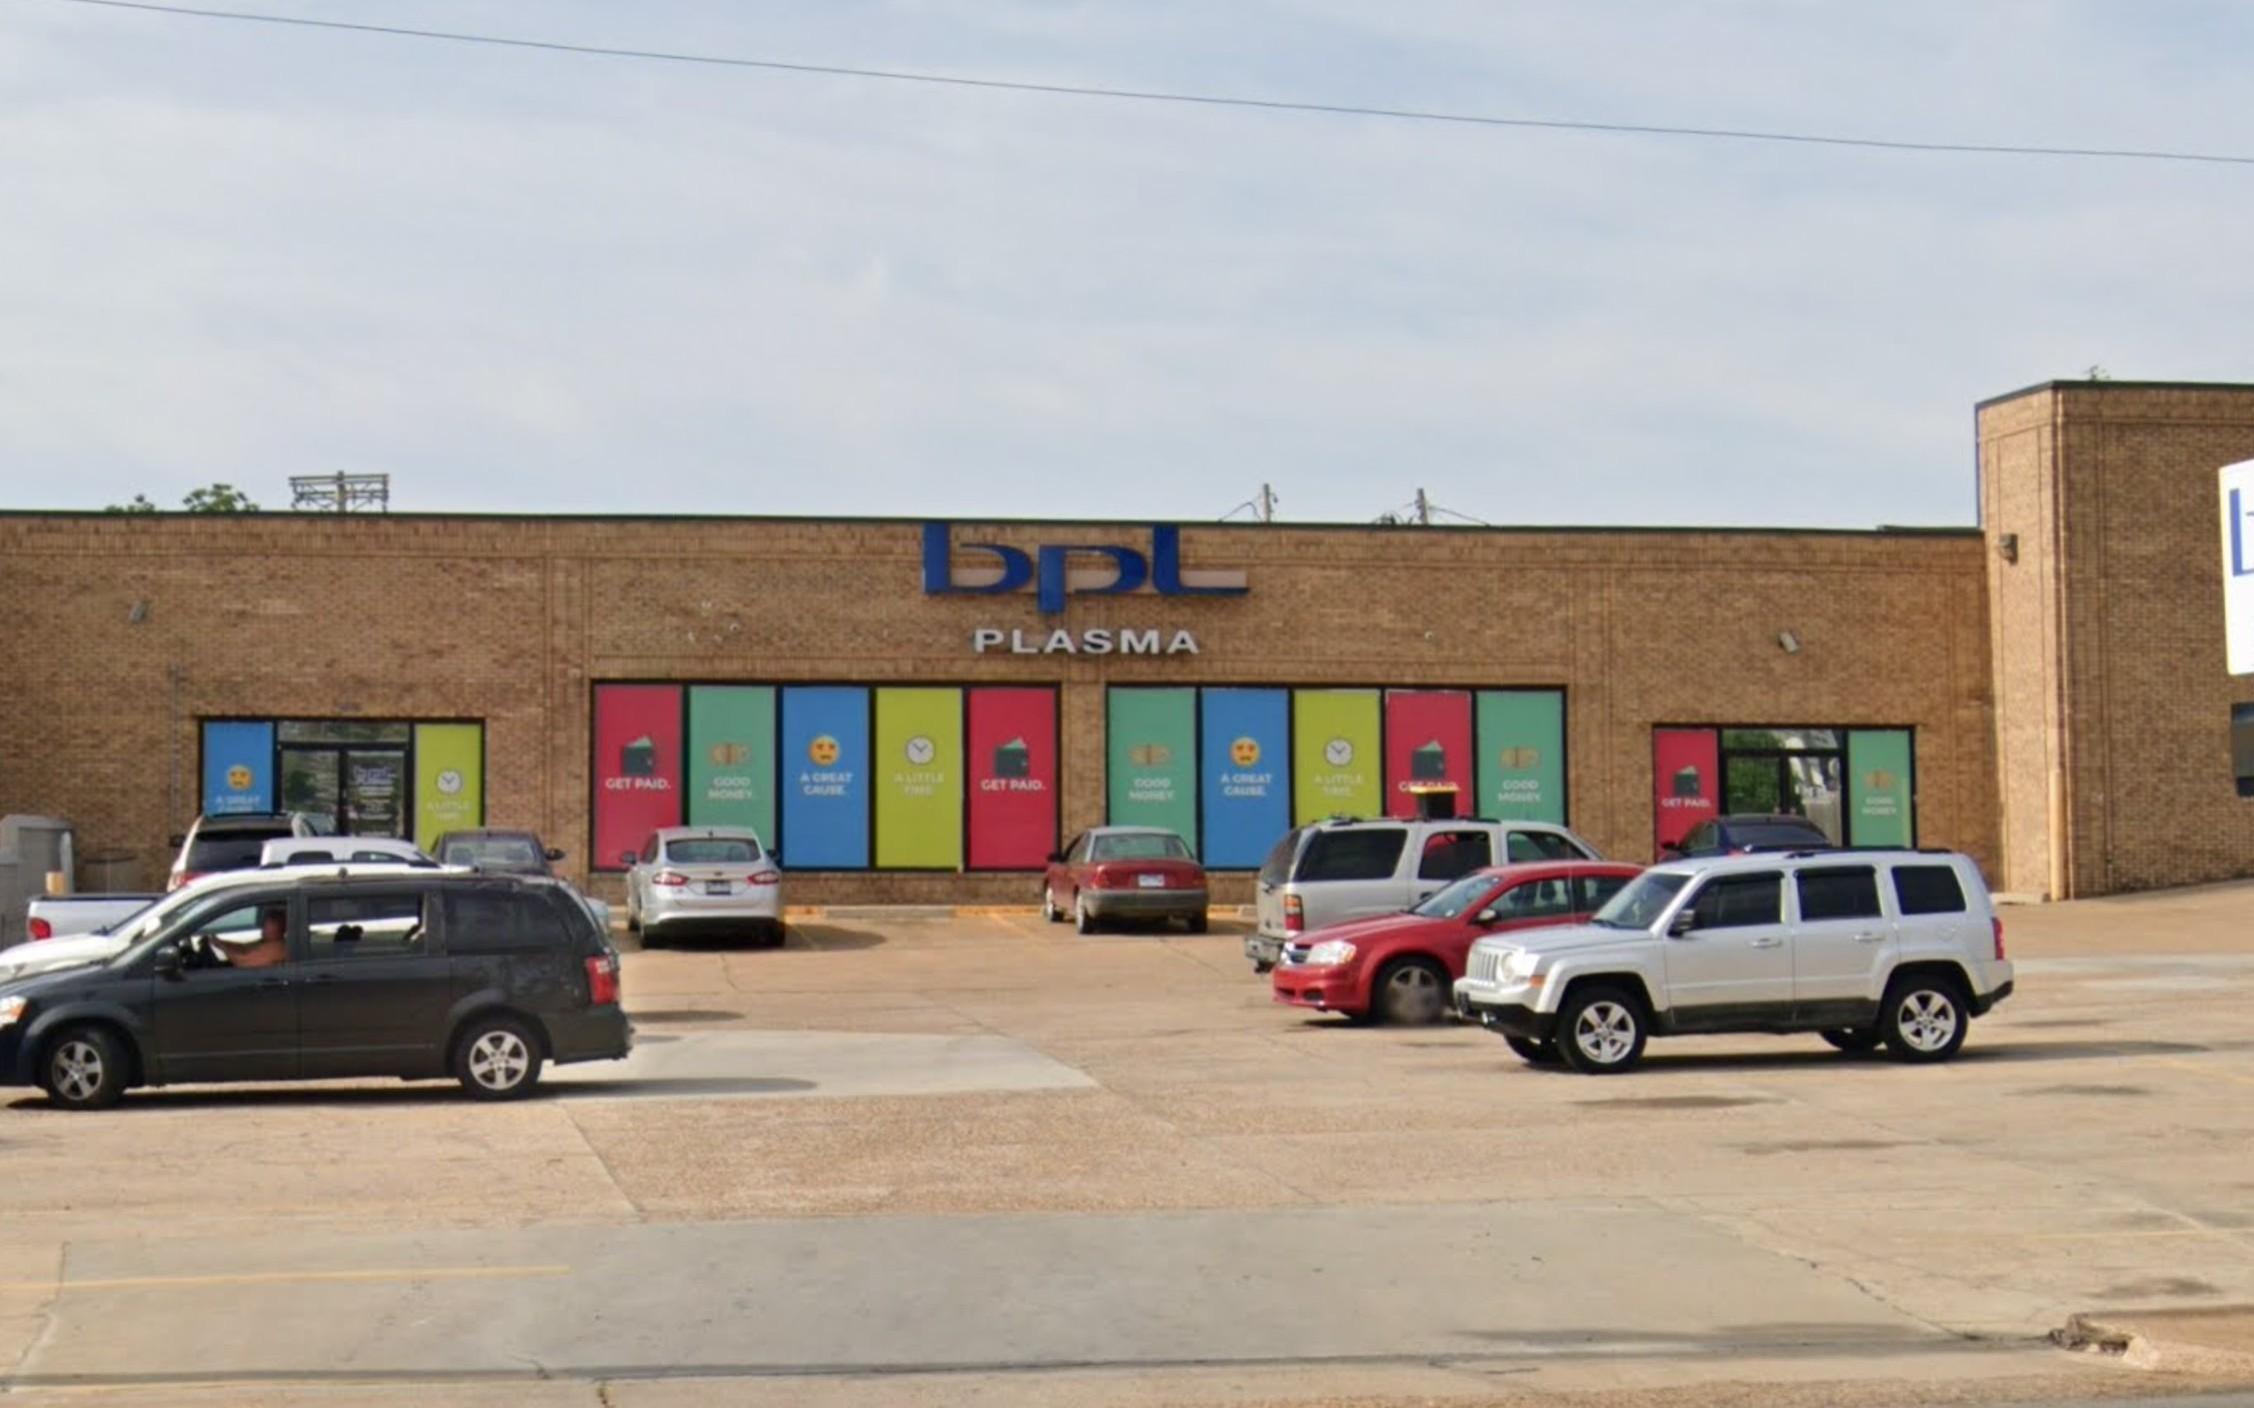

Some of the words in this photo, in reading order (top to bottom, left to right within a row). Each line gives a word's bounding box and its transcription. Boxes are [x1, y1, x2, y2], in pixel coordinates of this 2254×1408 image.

[973, 629, 1199, 654] PLASMA
[605, 777, 631, 789] GET
[634, 777, 671, 789] PAID.
[713, 777, 751, 787] GOOD
[800, 772, 809, 783] A
[812, 772, 853, 783] GREAT
[1220, 773, 1229, 783] A
[1232, 773, 1272, 784] GREAT
[981, 778, 1006, 790] GET
[1010, 778, 1047, 791] PAID.
[1134, 778, 1171, 789] GOOD
[1502, 779, 1539, 790] GOOD
[1661, 798, 1681, 808] GET
